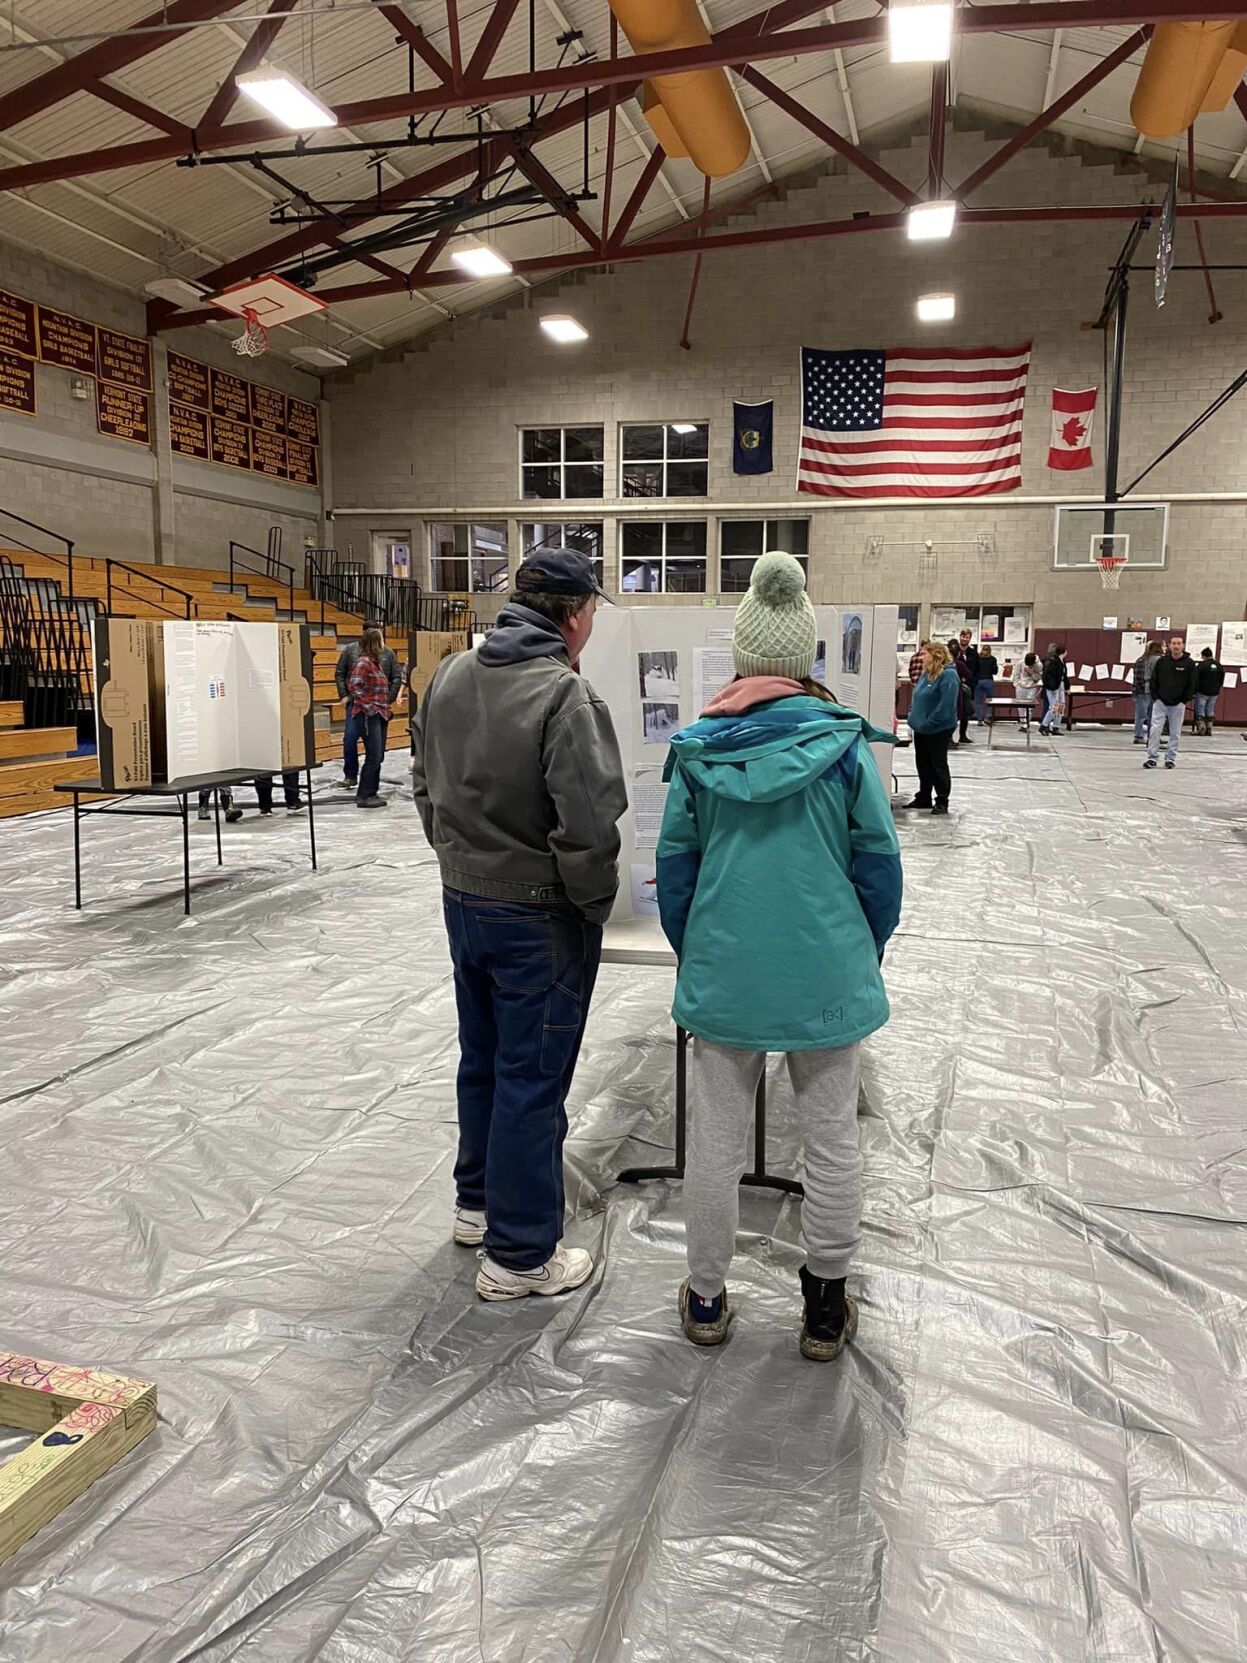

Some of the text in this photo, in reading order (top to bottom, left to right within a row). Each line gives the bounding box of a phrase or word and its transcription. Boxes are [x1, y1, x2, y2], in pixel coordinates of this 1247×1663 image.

[48, 331, 89, 350] CHAMPIONS
[106, 346, 134, 361] DIVISION
[120, 361, 146, 376] SOFTBALL
[101, 394, 145, 414] RUNNER-UP
[104, 385, 143, 405] VERMONT STATE
[106, 405, 132, 419] DIVISION
[100, 412, 147, 432] CHEERLEADING
